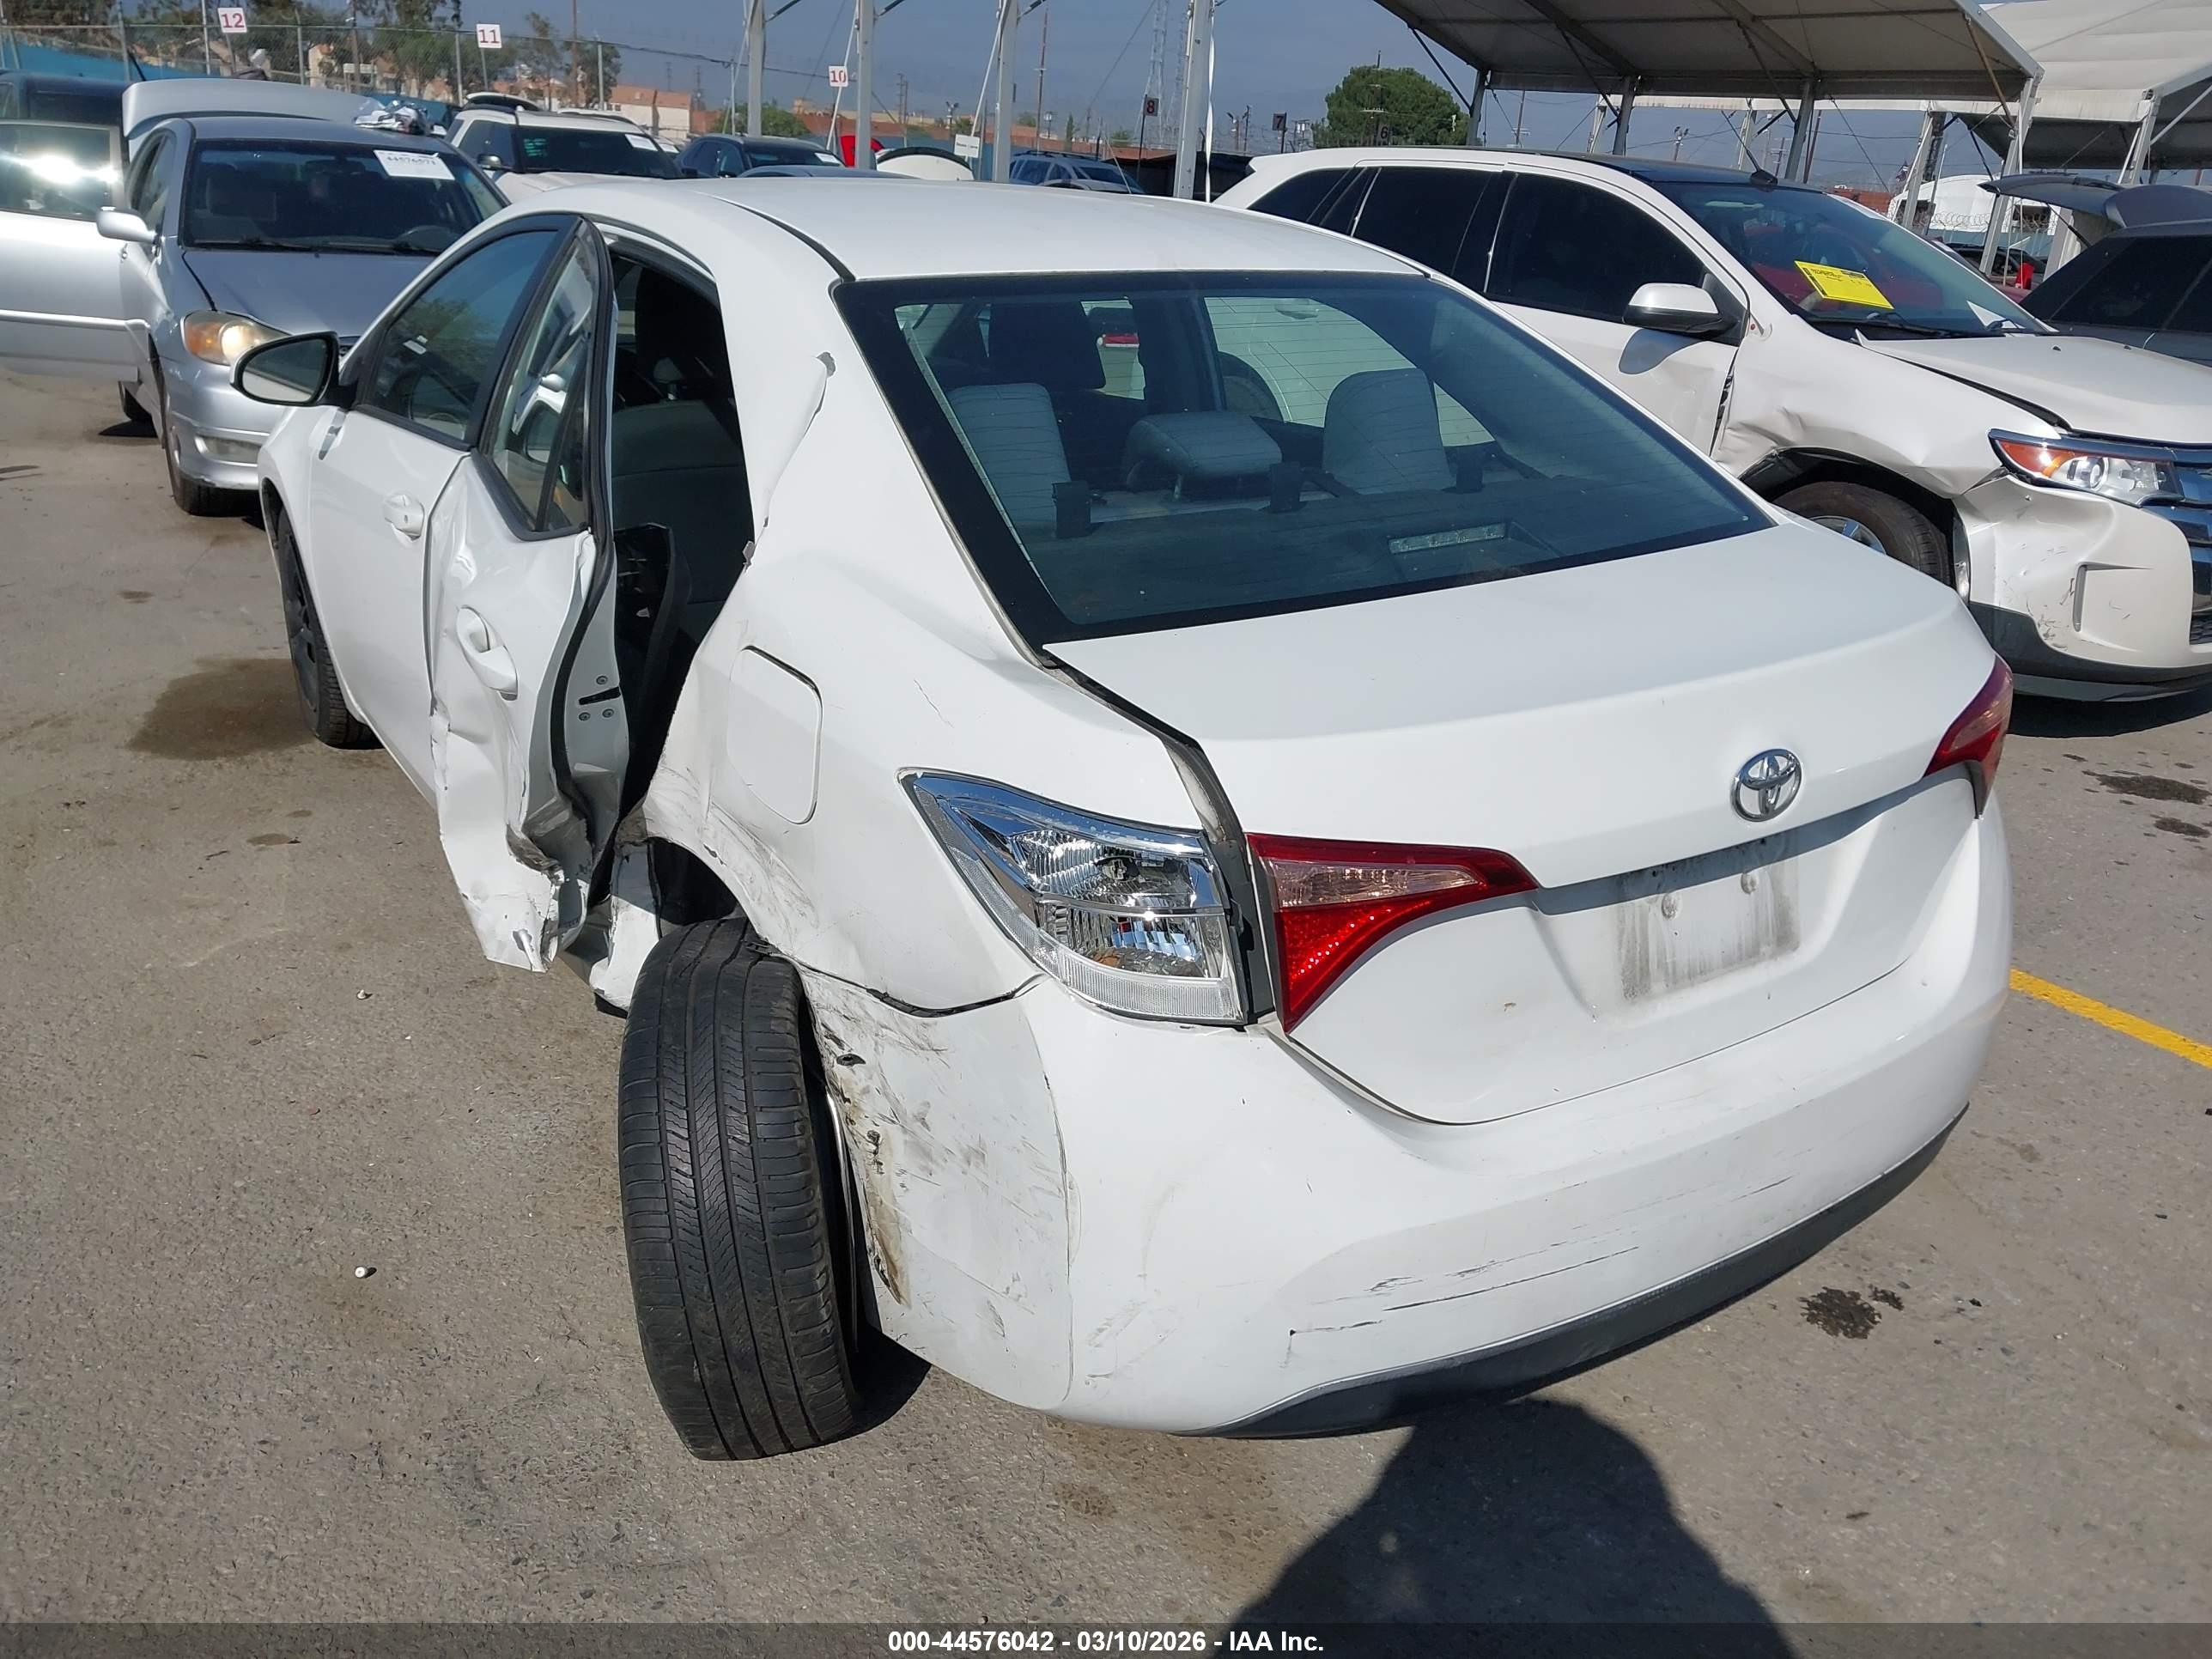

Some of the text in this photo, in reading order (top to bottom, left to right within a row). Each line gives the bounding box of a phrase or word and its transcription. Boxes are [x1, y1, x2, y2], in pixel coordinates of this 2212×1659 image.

[221, 13, 245, 27] 12
[478, 29, 500, 43] 11
[830, 70, 847, 82] 10
[1146, 100, 1155, 113] 8
[1276, 115, 1285, 129] 7
[1381, 126, 1389, 138] 6
